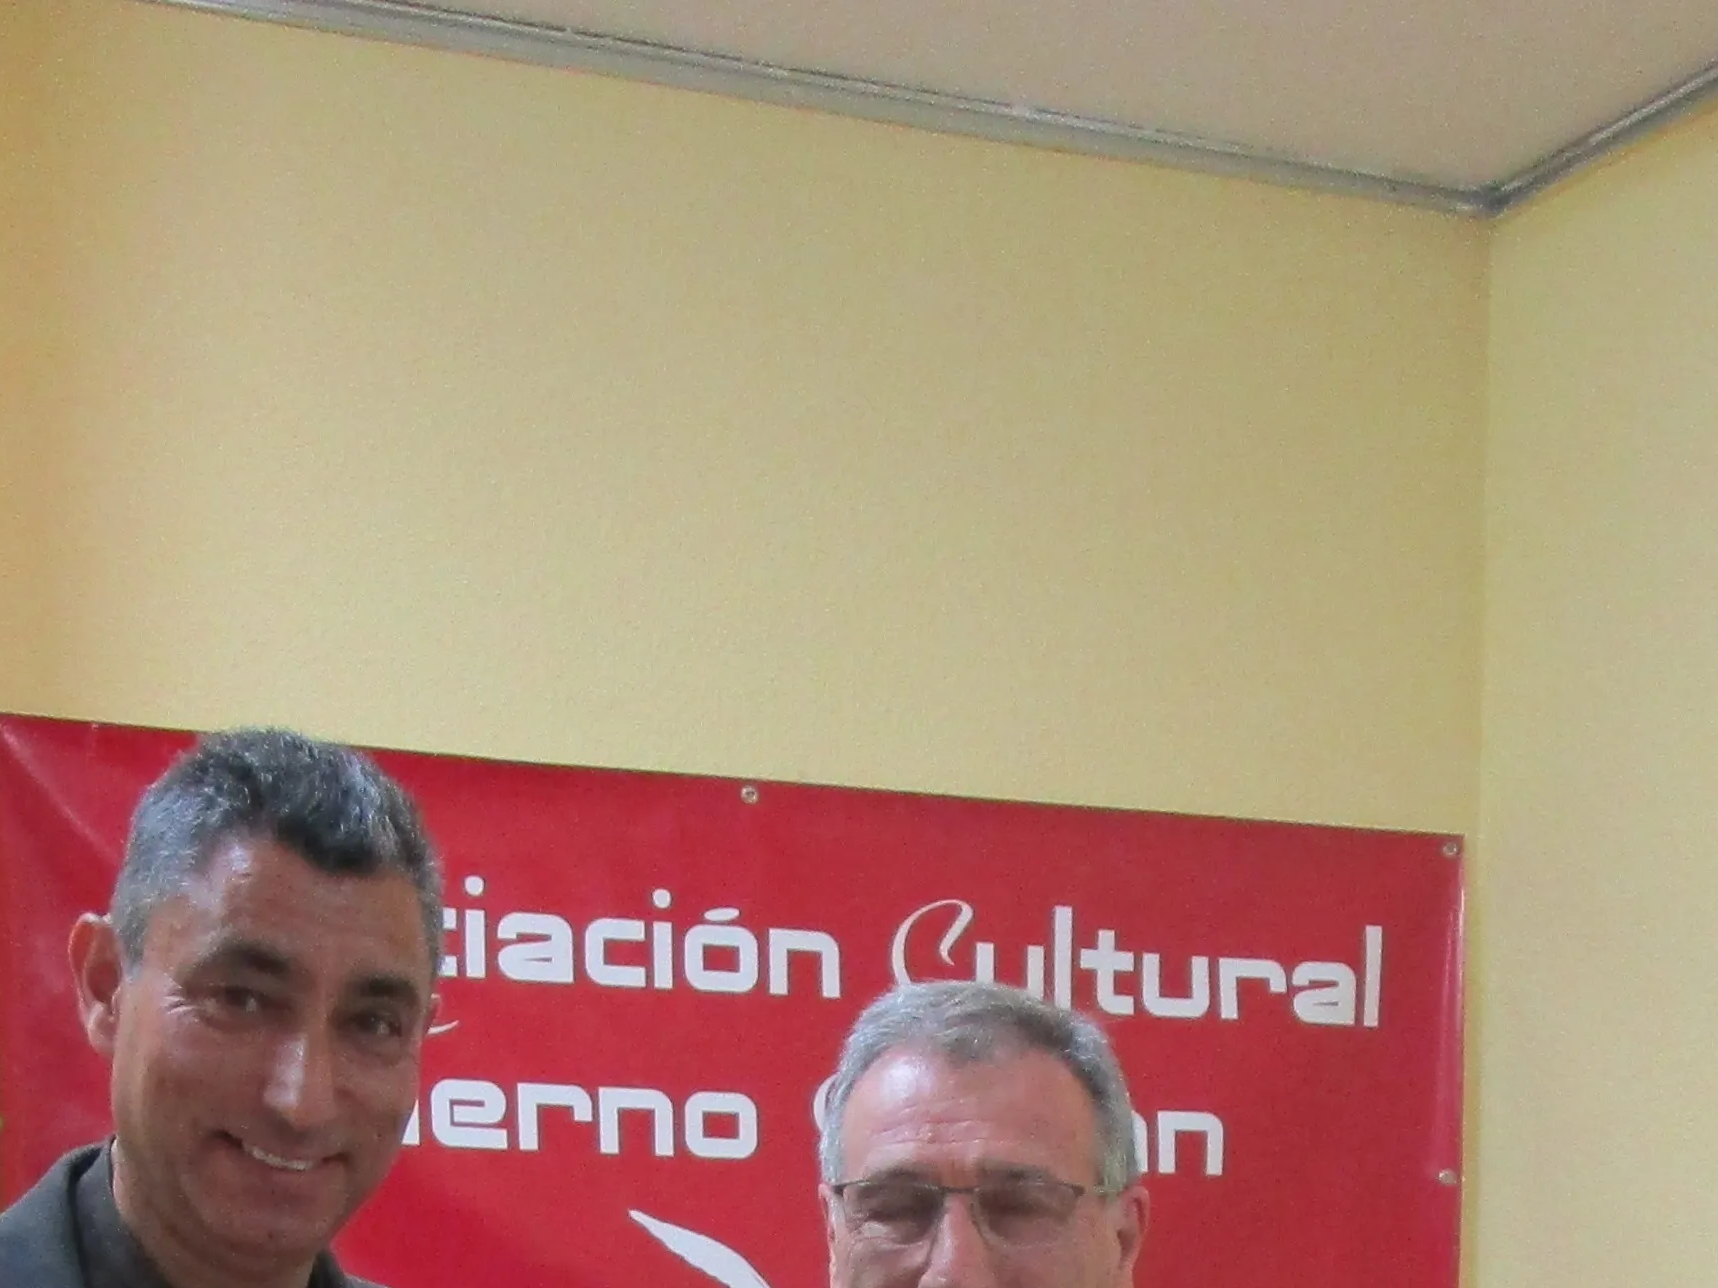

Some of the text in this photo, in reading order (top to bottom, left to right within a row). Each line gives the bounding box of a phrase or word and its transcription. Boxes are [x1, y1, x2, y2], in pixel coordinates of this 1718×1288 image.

[438, 875, 1382, 1027] iación Cultural
[402, 1079, 758, 1160] erno
